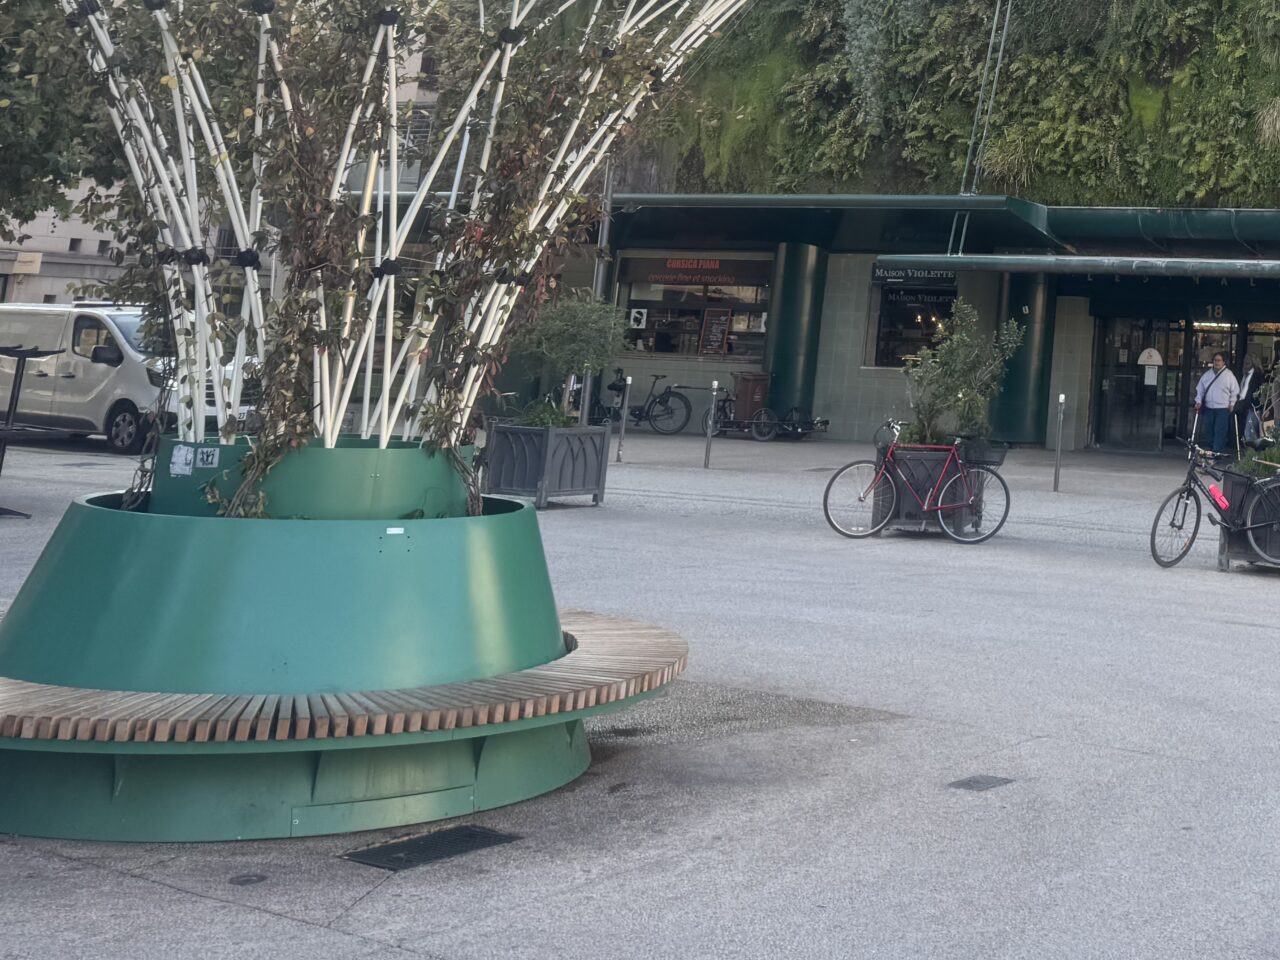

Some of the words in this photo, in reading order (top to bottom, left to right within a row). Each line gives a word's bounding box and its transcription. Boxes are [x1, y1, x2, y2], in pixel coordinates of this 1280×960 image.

[875, 268, 905, 277] MAISON
[907, 269, 955, 278] VIOLETTE
[1206, 304, 1223, 318] 18
